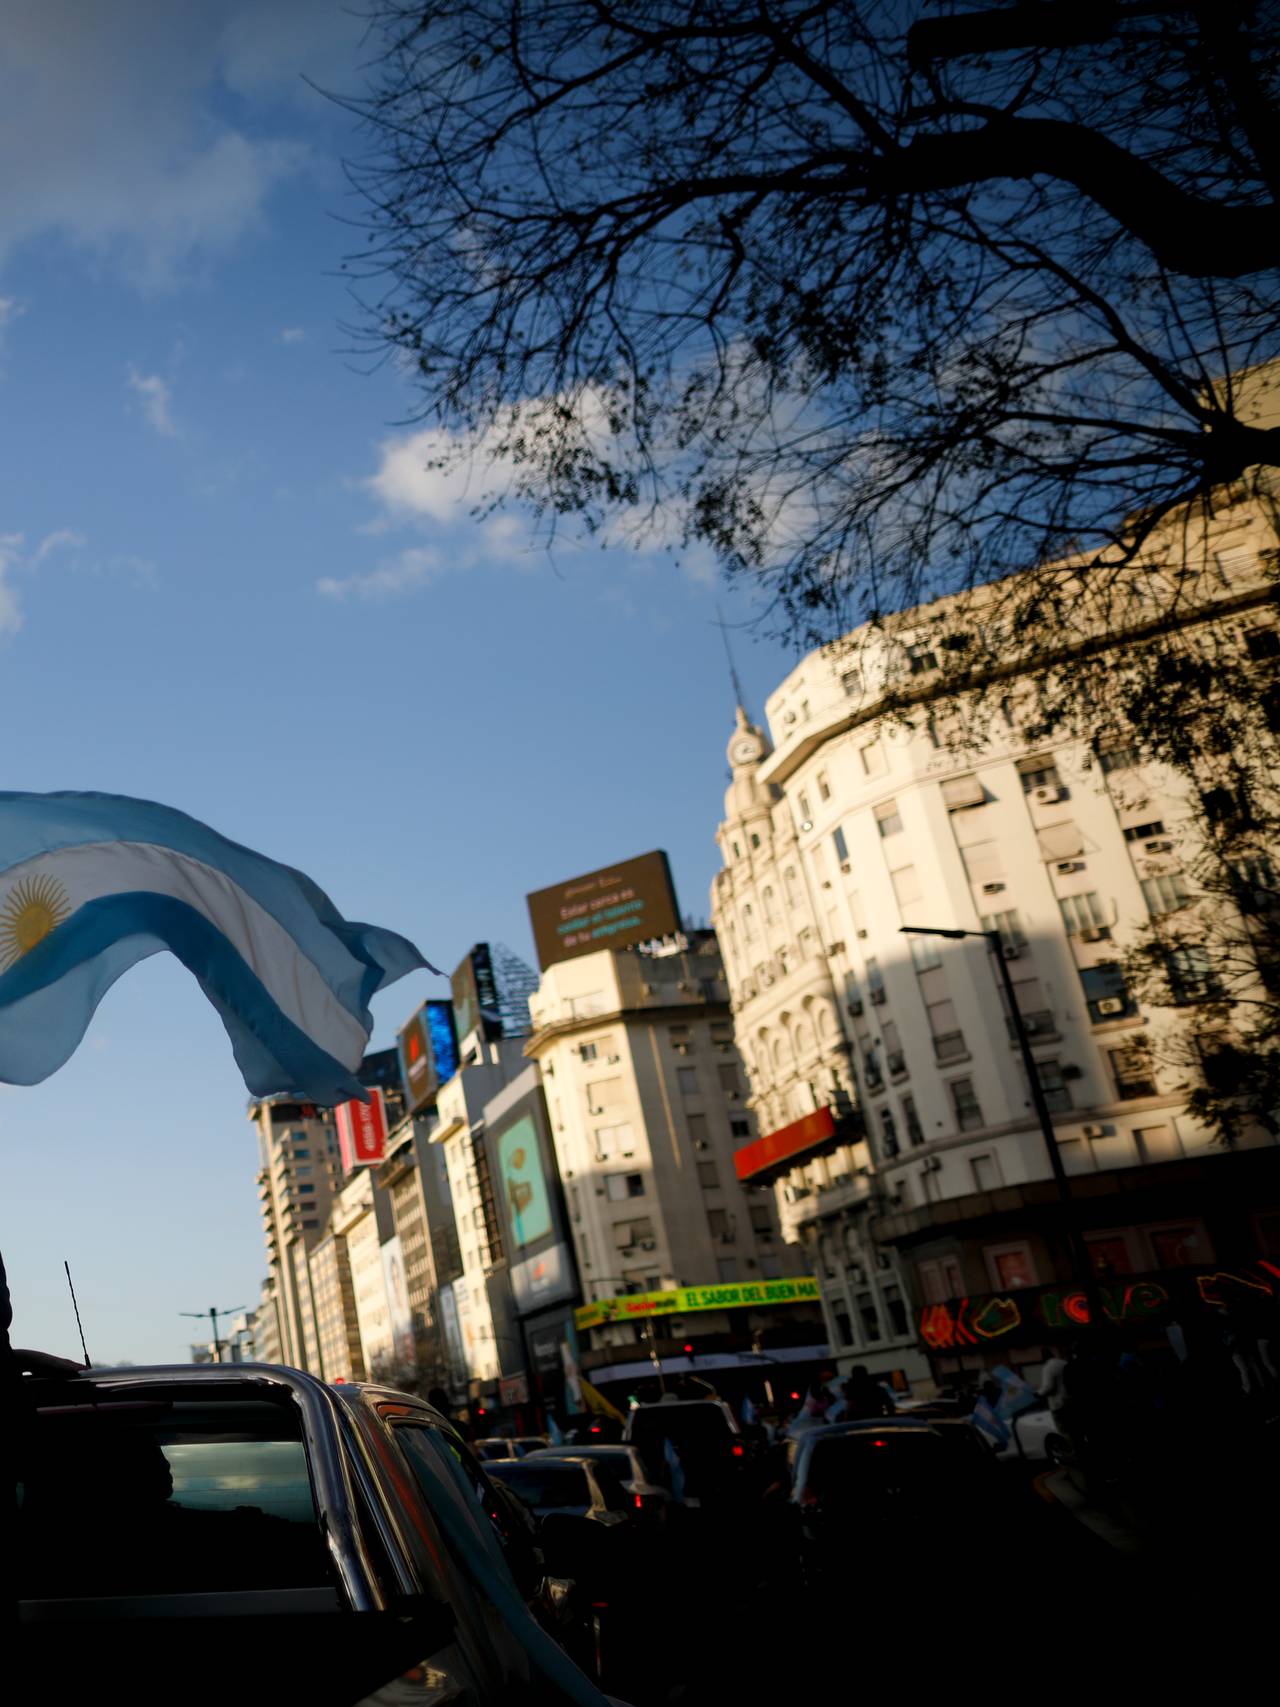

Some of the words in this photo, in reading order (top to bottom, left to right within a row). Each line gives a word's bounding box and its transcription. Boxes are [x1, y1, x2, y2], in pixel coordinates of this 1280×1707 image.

[686, 1291, 700, 1307] EL
[701, 1287, 739, 1305] SABOR
[741, 1285, 761, 1302] DEL
[764, 1283, 796, 1300] BUEN
